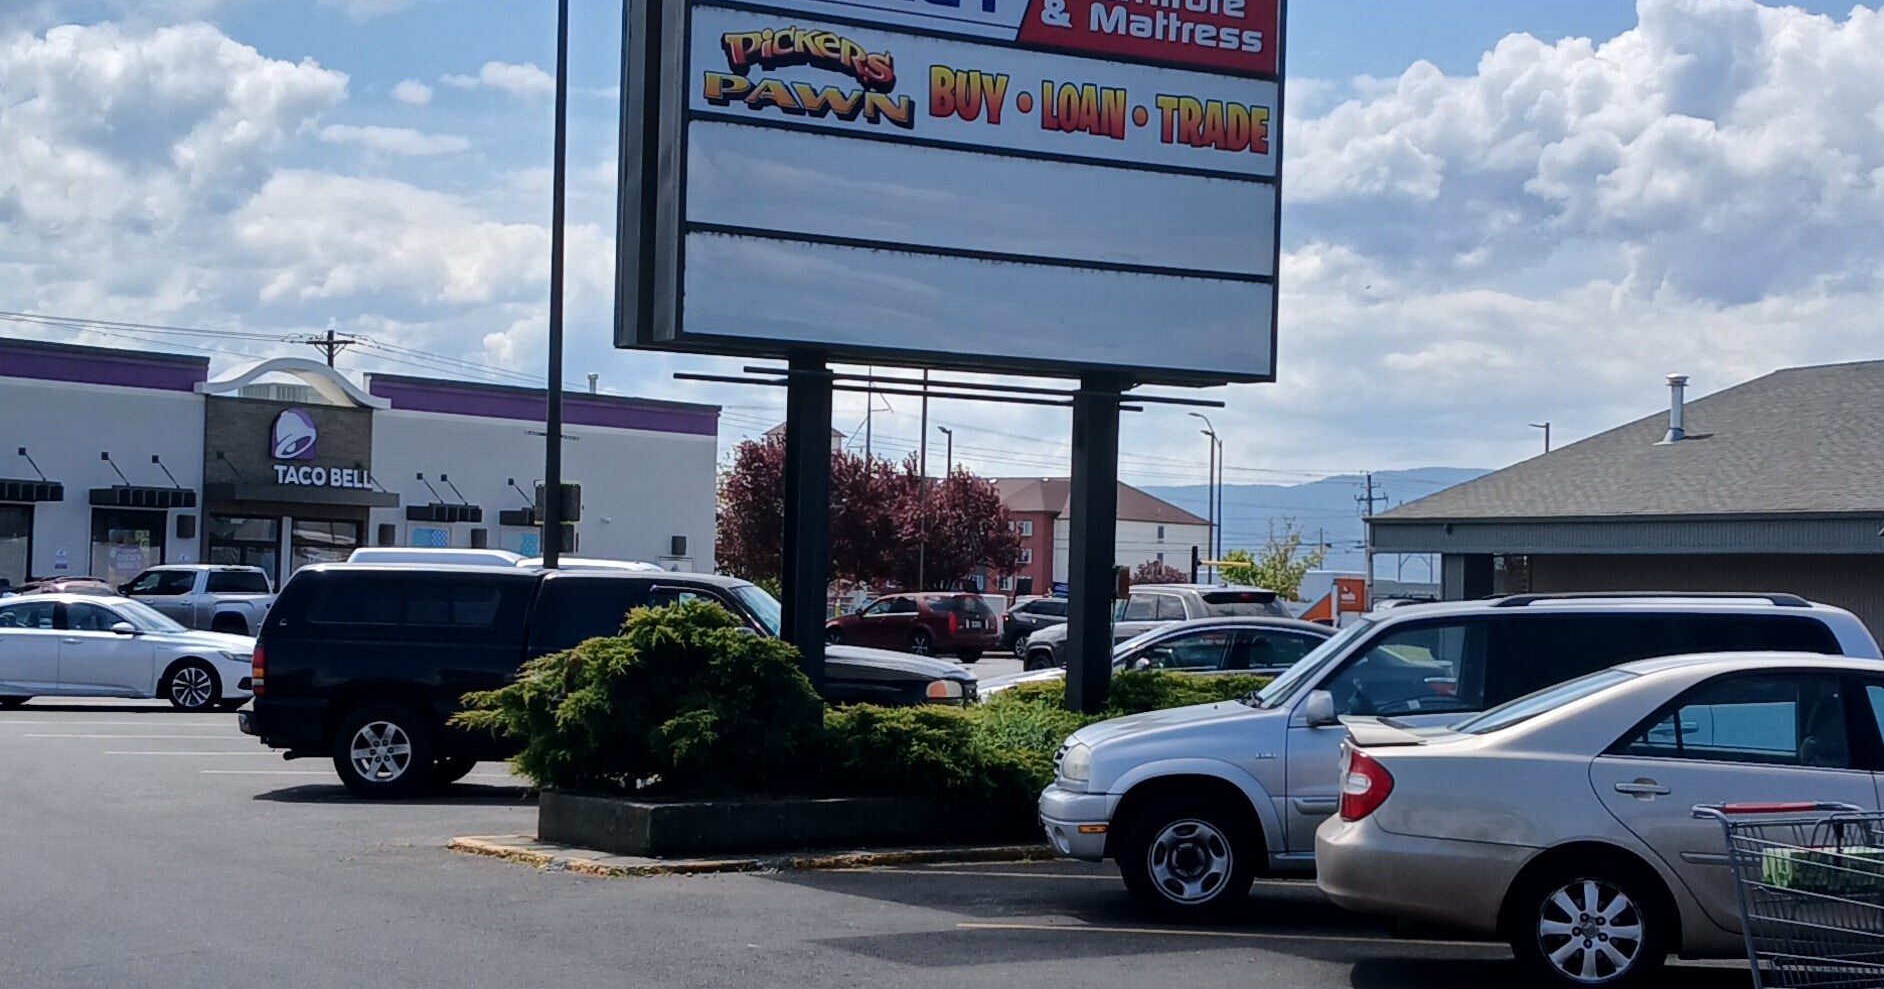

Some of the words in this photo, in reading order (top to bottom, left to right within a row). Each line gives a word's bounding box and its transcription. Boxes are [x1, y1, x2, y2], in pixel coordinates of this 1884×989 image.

[1088, 2, 1264, 54] Mattress
[703, 70, 914, 130] PAWN
[929, 64, 1009, 125] BUY
[1041, 79, 1126, 140] LOAN
[1155, 95, 1269, 154] TRADE
[273, 464, 326, 486] TACO
[330, 467, 373, 489] BELL
